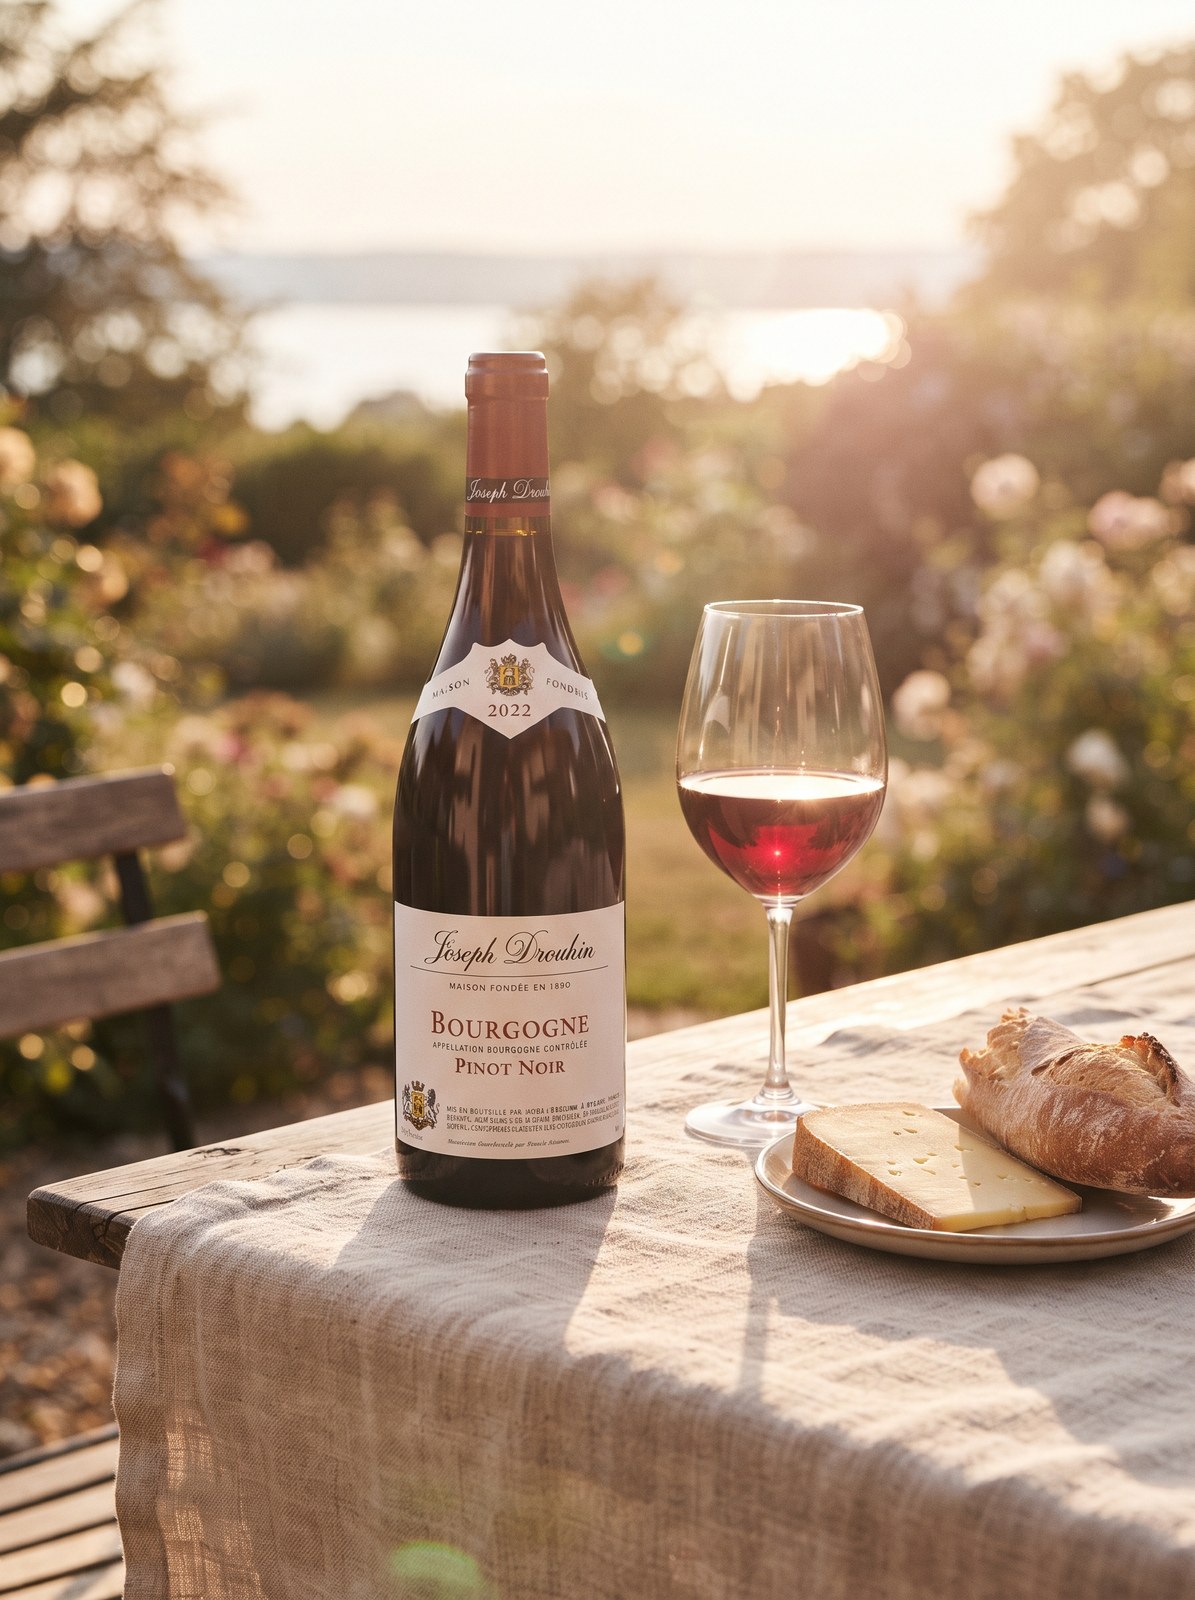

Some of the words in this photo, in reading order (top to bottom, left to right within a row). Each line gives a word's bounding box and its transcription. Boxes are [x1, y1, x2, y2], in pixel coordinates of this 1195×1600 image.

[466, 478, 508, 504] Joseph
[487, 704, 531, 717] 2022
[424, 929, 498, 971] Joseph
[503, 929, 596, 965] Drouhin
[449, 982, 486, 992] MAISON
[490, 982, 529, 992] FONDÉE
[533, 983, 546, 991] EN
[550, 981, 571, 990] 1890
[431, 1010, 590, 1040] BOURGOGNE
[432, 1041, 484, 1053] APPELLATION
[487, 1045, 540, 1054] BOURGOGNE
[543, 1040, 588, 1053] CONTRÔLÉE
[455, 1057, 512, 1076] PINOT
[518, 1060, 566, 1075] NOIR
